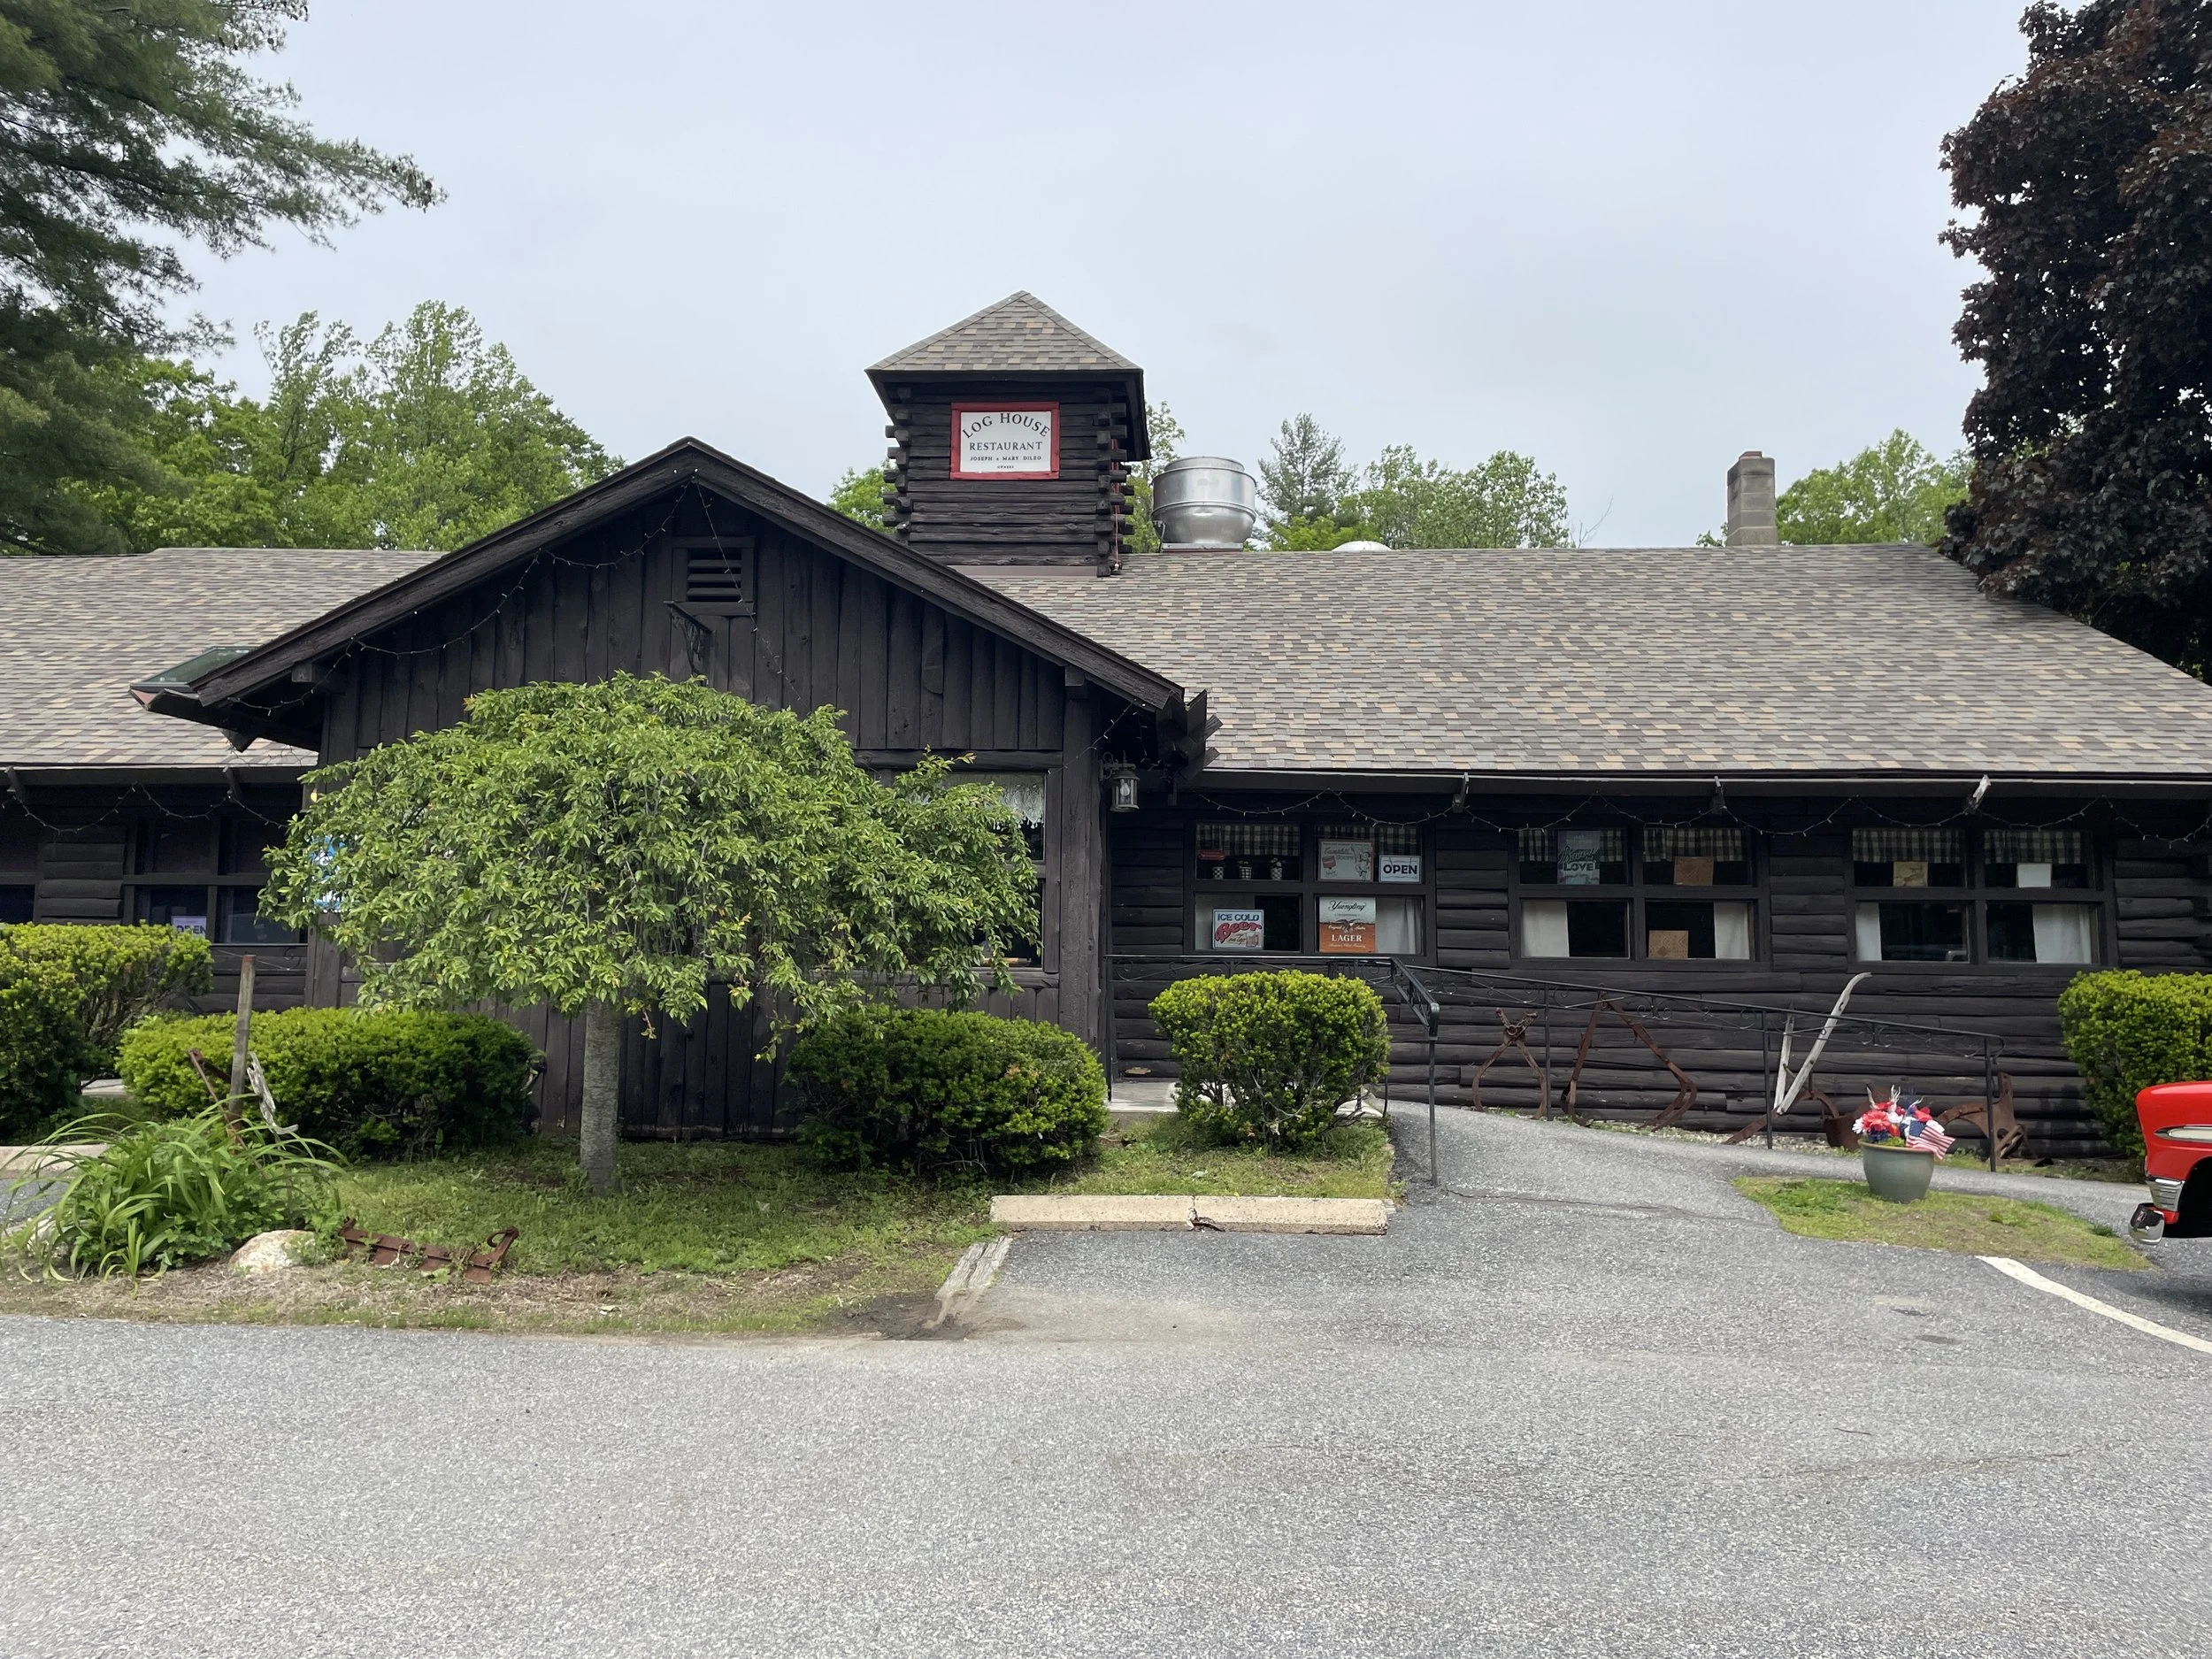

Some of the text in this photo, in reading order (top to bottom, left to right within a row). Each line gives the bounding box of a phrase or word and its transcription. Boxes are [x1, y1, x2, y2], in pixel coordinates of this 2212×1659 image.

[962, 412, 1050, 438] LOG HOUSE
[969, 442, 1043, 450] RESTAURANT
[1383, 864, 1417, 874] OPEN
[1328, 900, 1366, 911] Yuengling
[1214, 922, 1263, 944] Beer
